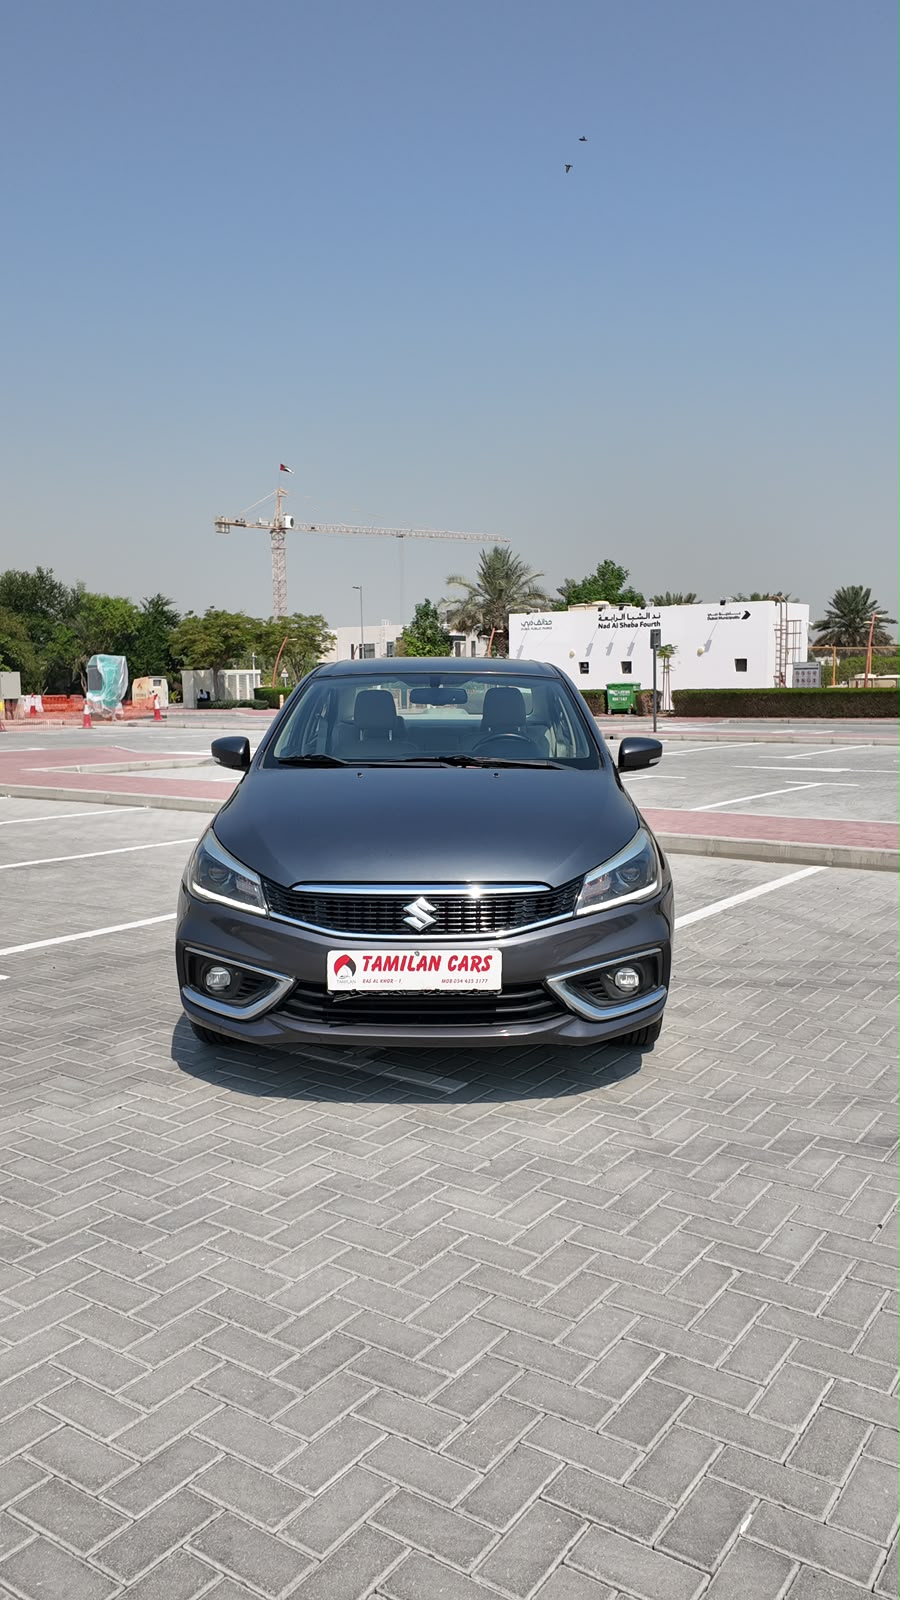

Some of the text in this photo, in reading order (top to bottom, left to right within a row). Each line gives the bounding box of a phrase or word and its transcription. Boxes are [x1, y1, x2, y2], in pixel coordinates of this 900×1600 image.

[619, 621, 639, 629] Sheba
[639, 620, 661, 628] Fourth
[362, 955, 493, 973] TAMILAN CARS
